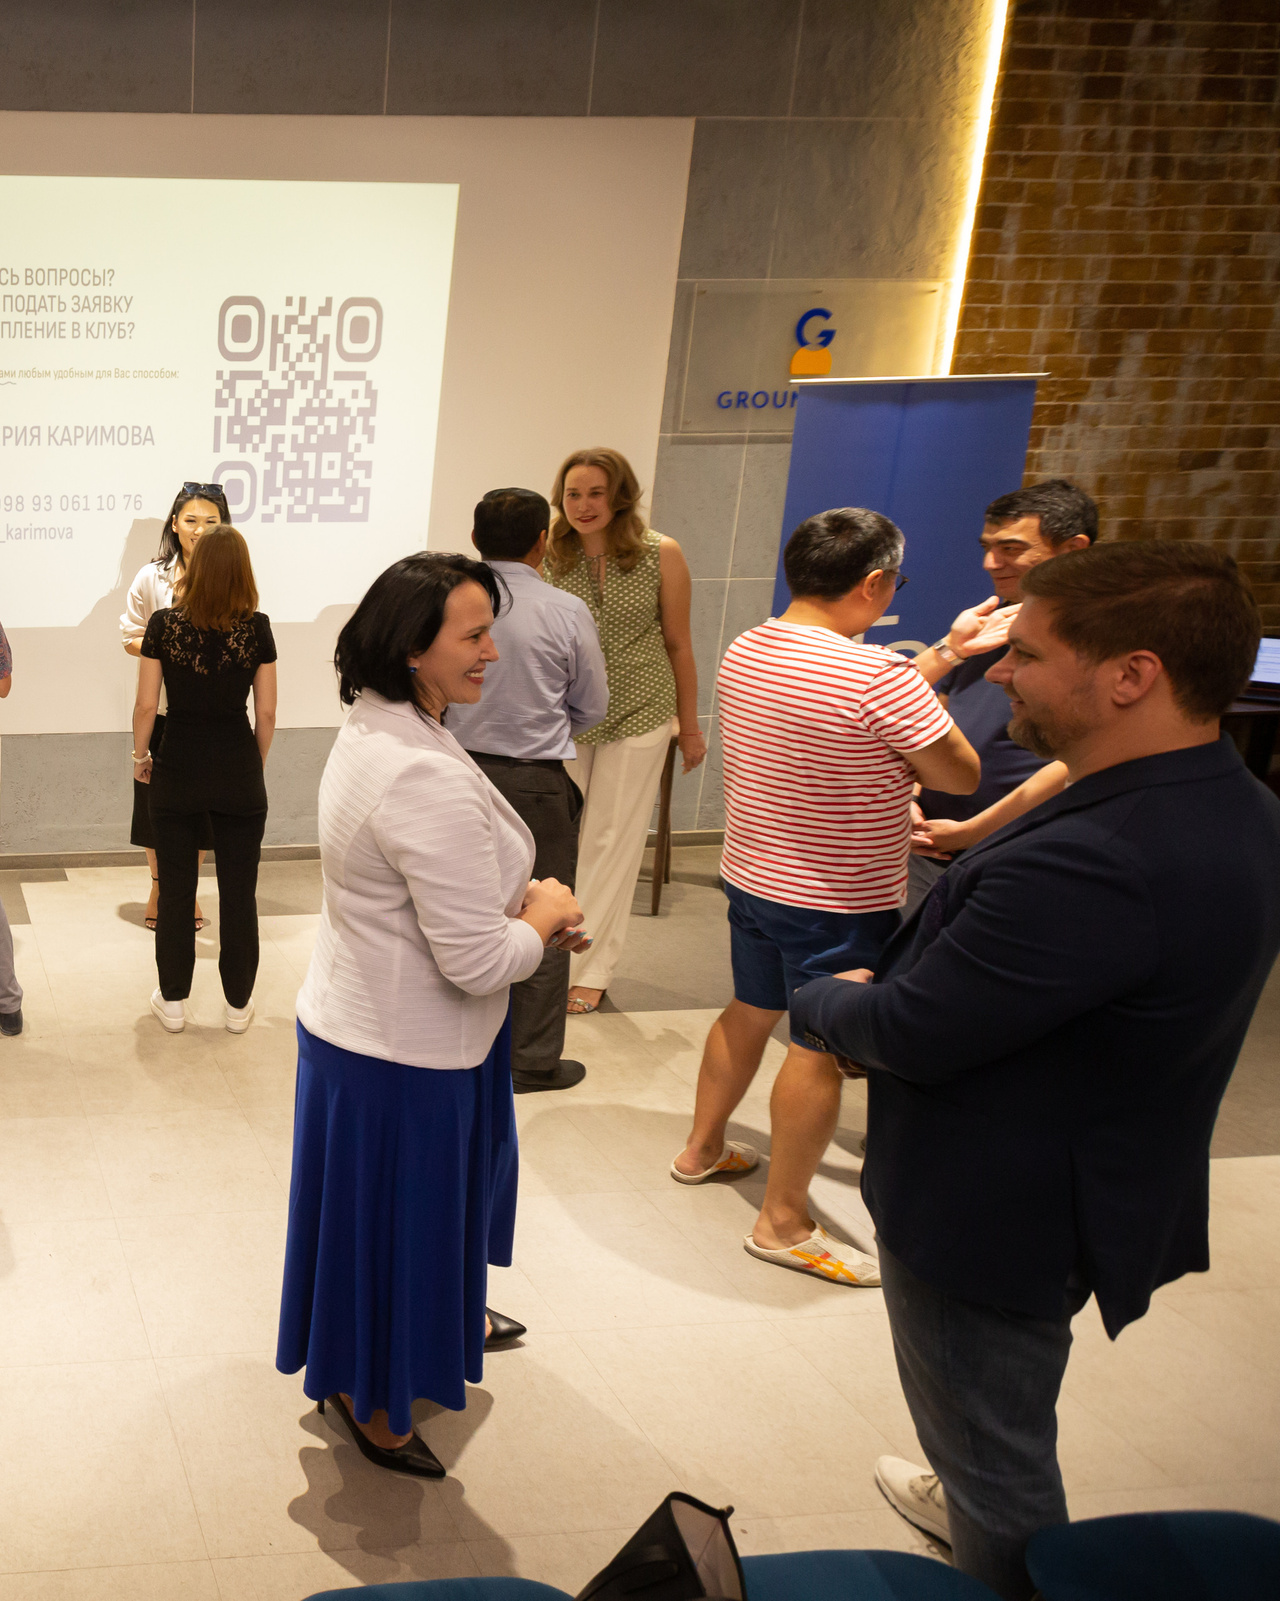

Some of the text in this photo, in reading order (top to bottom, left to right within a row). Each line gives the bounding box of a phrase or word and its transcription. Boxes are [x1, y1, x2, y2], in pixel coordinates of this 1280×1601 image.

[24, 268, 116, 287] ВОПРОСЫ?
[2, 294, 67, 316] ПОДАТЬ
[71, 295, 134, 314] ЗАЯВКУ
[71, 321, 81, 339] В
[85, 321, 136, 340] КЛУБ?
[18, 367, 51, 379] любым
[53, 367, 94, 381] удобным
[95, 369, 112, 380] для
[114, 367, 131, 379] Вас
[132, 367, 180, 380] способом:
[47, 425, 155, 447] КАРИМОВА
[32, 495, 53, 512] 93
[59, 494, 90, 512] 061
[96, 494, 116, 511] 10
[123, 494, 143, 511] 76
